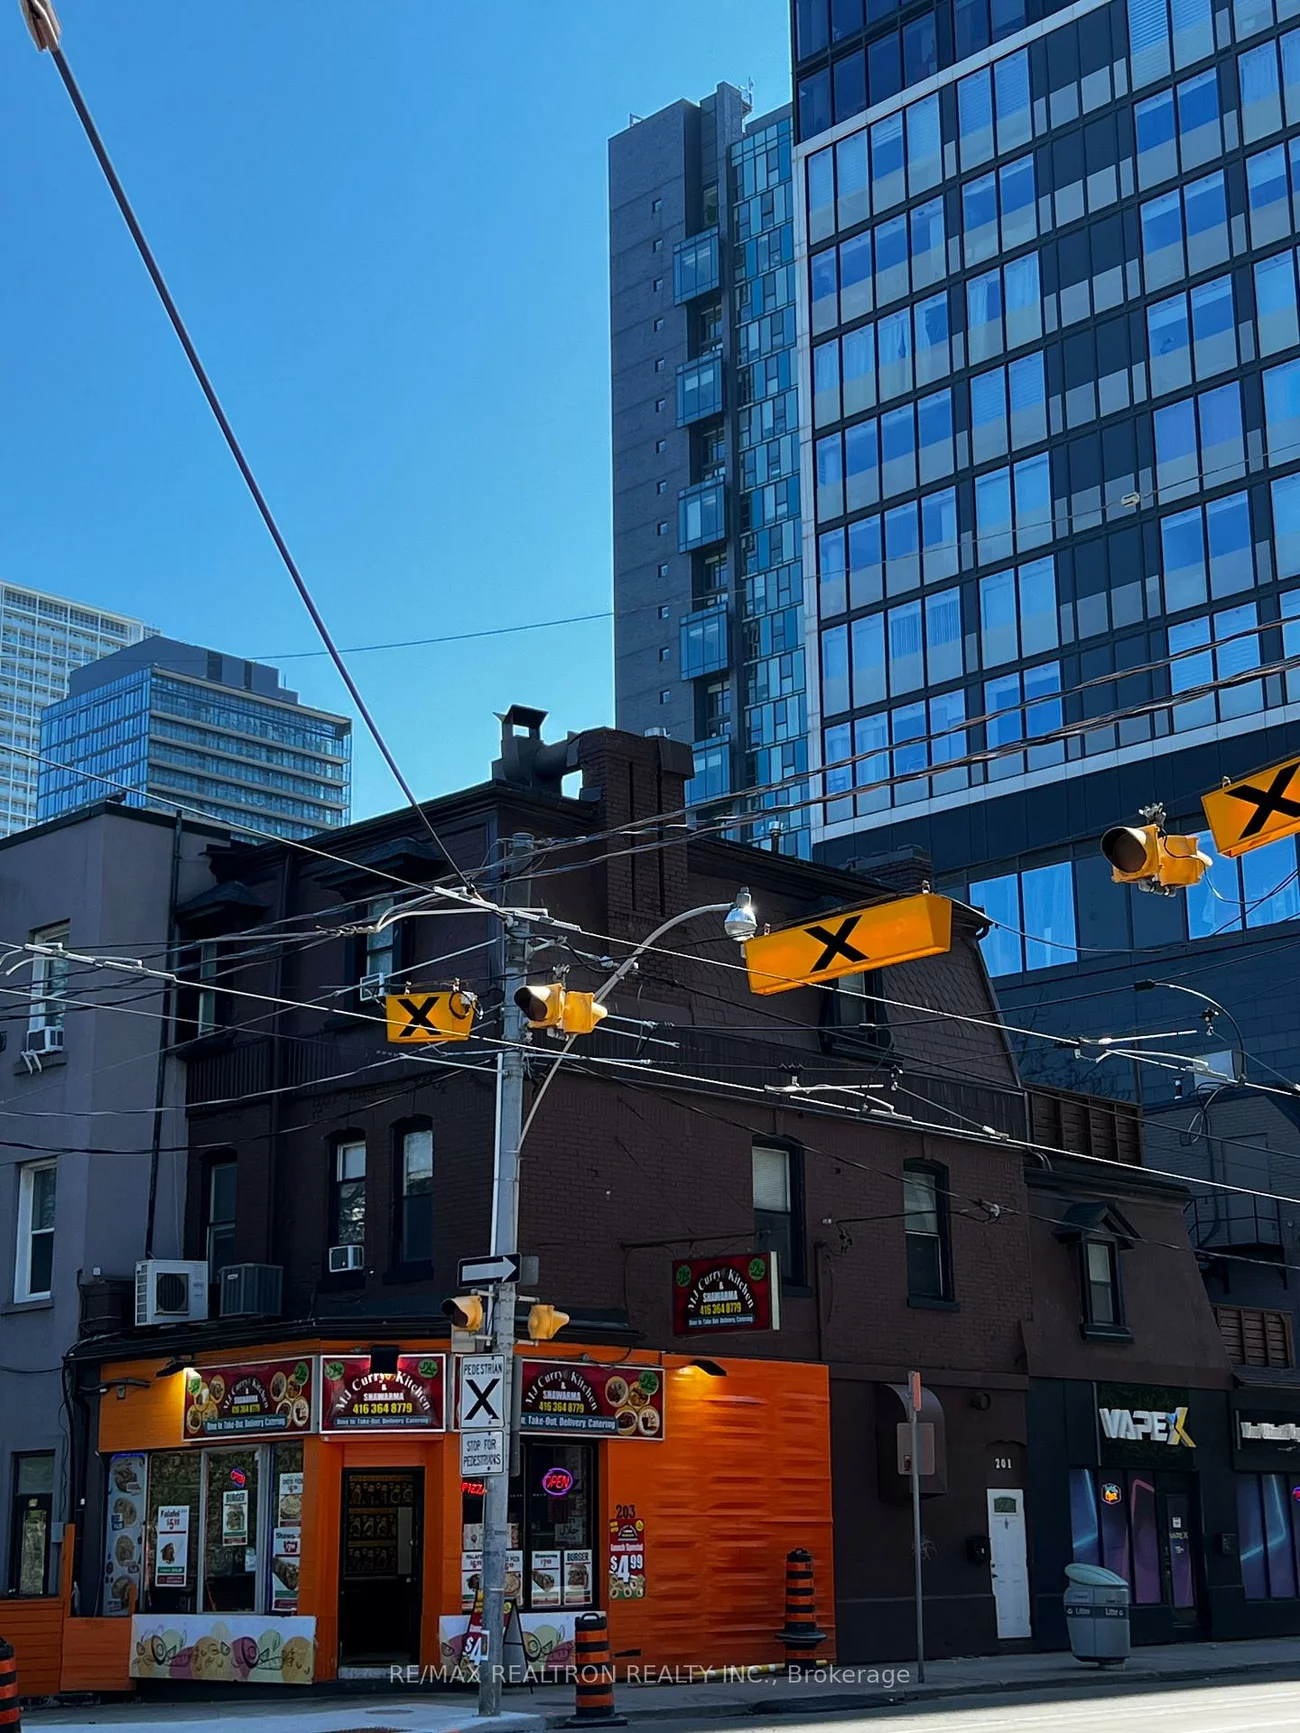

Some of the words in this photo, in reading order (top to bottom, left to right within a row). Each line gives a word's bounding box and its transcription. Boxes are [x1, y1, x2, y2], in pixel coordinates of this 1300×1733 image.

[698, 1270, 720, 1290] Curry
[728, 1268, 754, 1308] Kitchen
[700, 1304, 711, 1315] 416
[712, 1304, 725, 1314] 364
[726, 1302, 742, 1313] 8779
[464, 1363, 502, 1376] PEDESTRIAN
[336, 1390, 352, 1412] MJ
[352, 1373, 385, 1391] Curry
[396, 1371, 431, 1410] Kitchen
[538, 1370, 562, 1388] Curry
[570, 1371, 598, 1410] Kitchen
[542, 1390, 582, 1401] SHAWARMA
[364, 1392, 404, 1402] SHAWARMA
[352, 1403, 370, 1414] 416
[370, 1403, 389, 1414] 364
[390, 1402, 412, 1414] 8779
[538, 1401, 552, 1412] 416
[552, 1402, 566, 1412] 364
[568, 1402, 584, 1413] 8779
[588, 1419, 616, 1430] Catering
[1099, 1406, 1197, 1448] VAPEX
[467, 1440, 480, 1452] STOP
[484, 1438, 496, 1450] FOR
[464, 1454, 500, 1467] PEDESTRIANS
[995, 1458, 1012, 1469] 201
[544, 1474, 570, 1488] OPEN
[616, 1504, 636, 1519] 203
